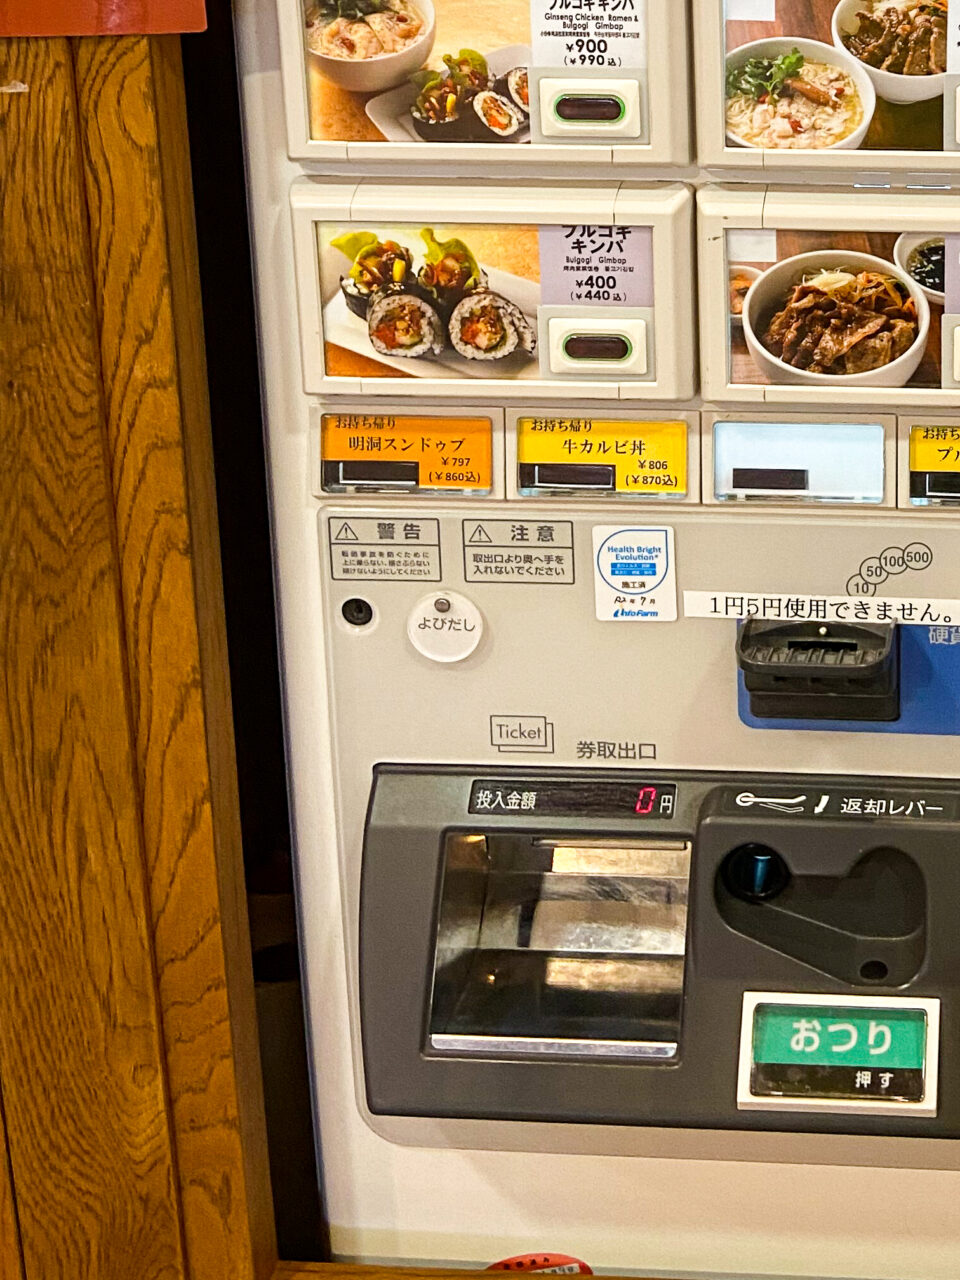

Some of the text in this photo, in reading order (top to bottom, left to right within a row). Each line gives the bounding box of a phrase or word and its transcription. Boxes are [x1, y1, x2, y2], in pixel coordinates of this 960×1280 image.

[545, 13, 632, 22] Ginseng Chicken Ramen
[562, 22, 624, 31] Bulgogi Gimbap
[566, 39, 608, 54] ¥900
[565, 256, 627, 265] Bulgogi Gimbap
[576, 275, 617, 289] ¥400
[335, 416, 396, 430] お持ち帰り
[531, 419, 593, 433] お持ち帰り
[348, 435, 466, 453] 明洞スンドゥブ
[562, 438, 646, 456] 牛カルビ丼
[441, 457, 471, 467] ¥797
[638, 460, 668, 470] ¥806
[377, 523, 421, 540] 警告
[511, 524, 555, 542] 注意
[637, 546, 662, 554] Bright
[905, 551, 929, 563] 500
[473, 553, 565, 565] 取出口より奥へ手を
[882, 556, 905, 568] 100
[473, 565, 565, 576] 入れないでください
[866, 566, 883, 578] 50
[853, 582, 869, 594] 10
[710, 596, 952, 624] 1円5円使用できません。
[418, 616, 476, 632] よびだし
[496, 722, 541, 740] Ticket
[576, 740, 657, 760] 券取出口
[476, 790, 537, 810] 投入金額
[635, 787, 656, 814] 0
[840, 797, 943, 816] 返却レバー
[790, 1019, 892, 1055] おつり
[855, 1070, 894, 1089] 押す
